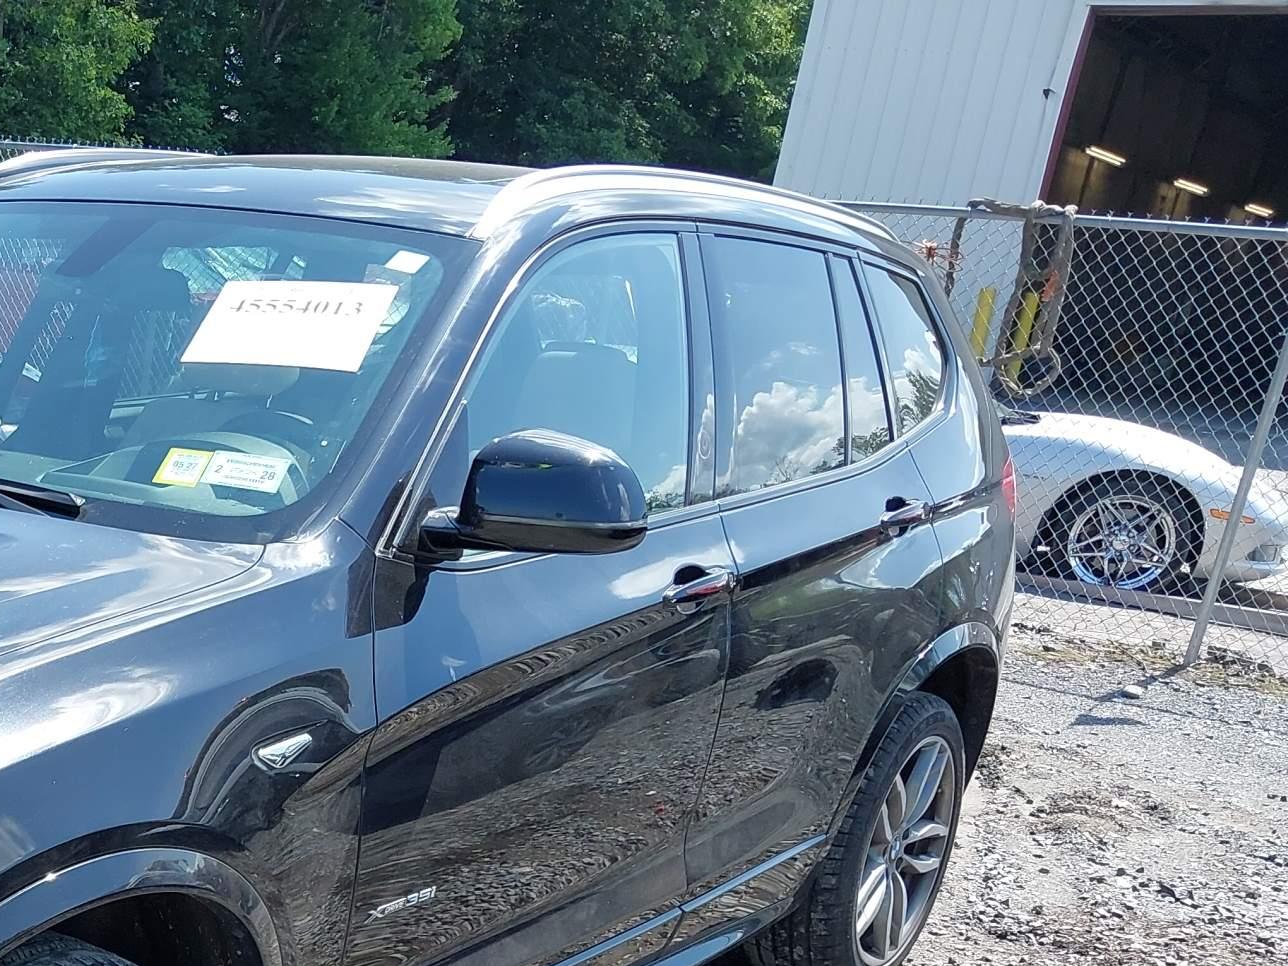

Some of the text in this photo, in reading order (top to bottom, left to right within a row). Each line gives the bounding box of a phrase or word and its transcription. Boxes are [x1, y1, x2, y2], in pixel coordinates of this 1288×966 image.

[230, 299, 364, 316] 45554013
[214, 464, 224, 474] 2
[260, 470, 276, 481] 28
